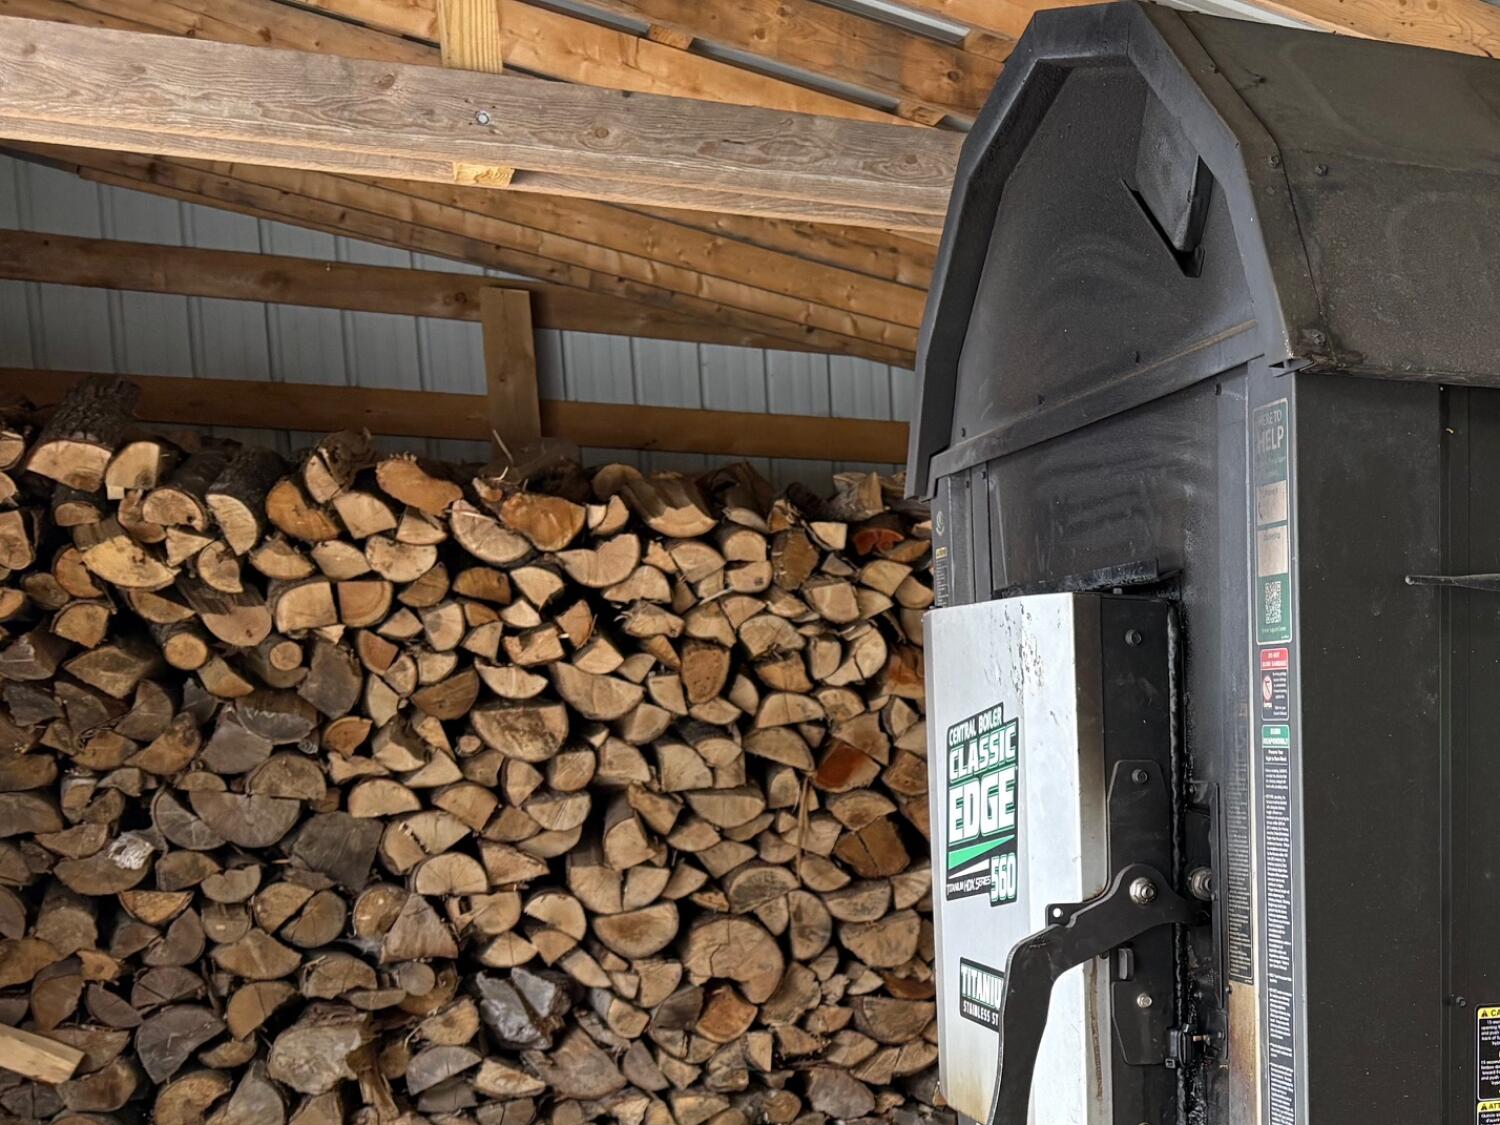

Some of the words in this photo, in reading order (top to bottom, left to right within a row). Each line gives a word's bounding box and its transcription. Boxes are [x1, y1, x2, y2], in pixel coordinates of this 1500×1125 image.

[949, 718, 977, 746] CENTRAL
[978, 706, 1003, 733] BOILER
[949, 723, 1016, 782] CLASSIC
[948, 767, 1016, 845] EDGE
[990, 852, 1016, 902] 560
[961, 963, 1003, 1011] TITANIU
